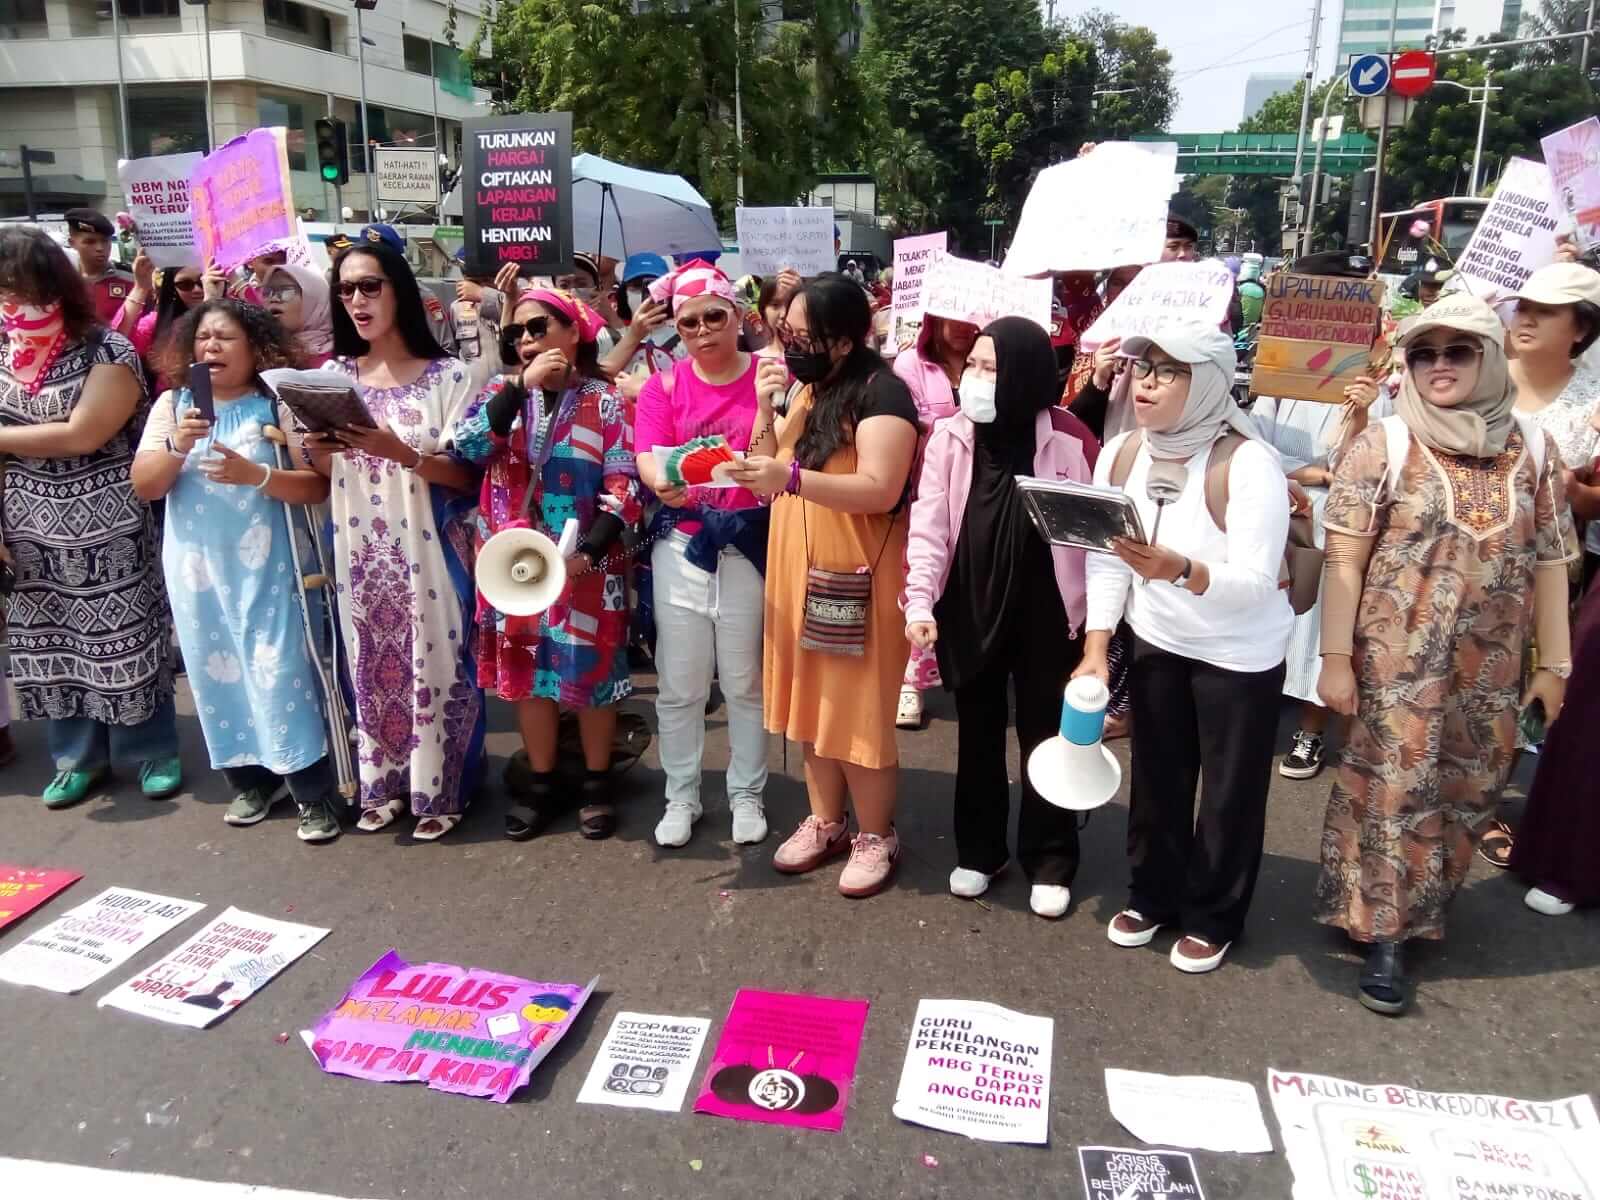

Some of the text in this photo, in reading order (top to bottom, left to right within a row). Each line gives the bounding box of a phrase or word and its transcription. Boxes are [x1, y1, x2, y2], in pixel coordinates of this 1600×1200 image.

[478, 131, 555, 148] TURUNKAN
[383, 160, 421, 169] HATI-HATI
[379, 172, 434, 182] DAERAH RAWAN
[383, 181, 431, 190] KECELAKAAN
[481, 169, 552, 187] CIPTAKAN
[131, 180, 163, 193] BBM
[131, 193, 164, 206] MBG
[477, 187, 557, 205] LAPANGAN
[1498, 190, 1549, 214] LINDUNGI
[1486, 214, 1533, 238] PEMBELA
[1492, 202, 1558, 232] PEREMPUAN
[481, 226, 552, 243] HENTIKAN
[1479, 226, 1503, 244] HAM,
[898, 250, 920, 262] TOLAK
[1472, 236, 1522, 263] LINDUNGI
[1465, 249, 1534, 281] MASA DEPAN
[1269, 275, 1377, 304] UPAH LAYAK
[96, 893, 189, 920] HIDUP LAGI
[212, 921, 278, 943] CIPTAKAN
[184, 942, 232, 960] KERJA
[199, 932, 270, 955] LAPANGAN
[83, 950, 114, 965] suka
[172, 953, 219, 970] LAYAK
[367, 970, 519, 1010] LULUS
[617, 1020, 660, 1030] STOP
[920, 1016, 973, 1030] GURU
[917, 1028, 1040, 1056] KEHILANGAN
[639, 1049, 690, 1059] ANGGARAN
[927, 1056, 1044, 1085] MBG TERUS
[975, 1076, 1043, 1096] DAPAT
[927, 1082, 1042, 1110] ANGGARAN
[1272, 1075, 1379, 1103] MALING
[1386, 1086, 1506, 1120] BERKEDOK
[1111, 1152, 1160, 1165] KRISIS
[1109, 1171, 1167, 1183] RAKYAT
